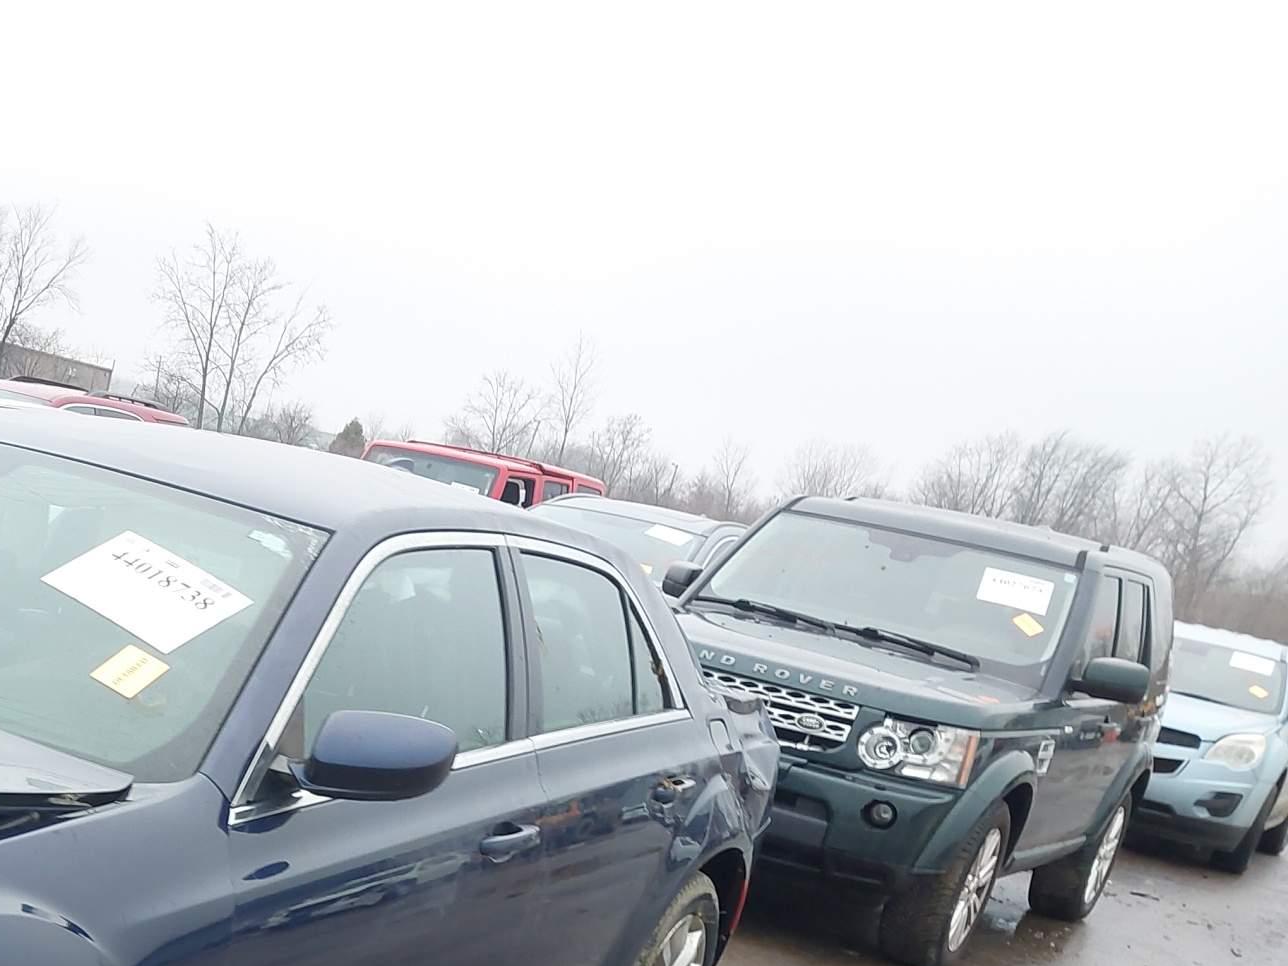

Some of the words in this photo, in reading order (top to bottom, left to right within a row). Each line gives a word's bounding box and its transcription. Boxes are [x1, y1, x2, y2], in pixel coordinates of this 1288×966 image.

[111, 550, 216, 611] 44018738
[699, 649, 736, 665] ND
[752, 662, 859, 697] ROVER
